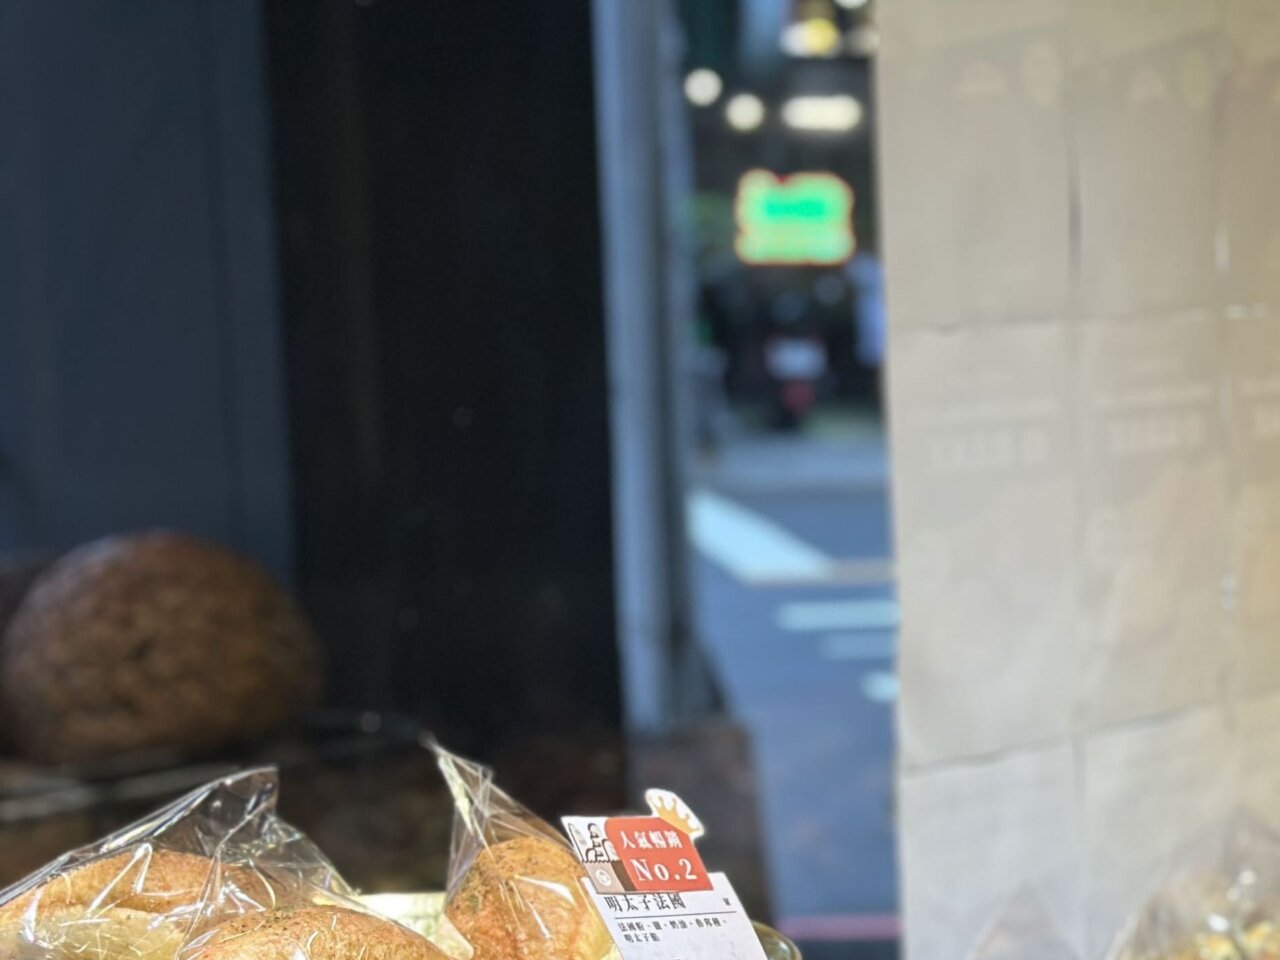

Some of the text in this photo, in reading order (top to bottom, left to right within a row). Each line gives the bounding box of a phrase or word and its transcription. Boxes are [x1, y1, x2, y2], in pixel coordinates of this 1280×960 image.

[619, 829, 684, 850] 人氣暢銷
[629, 857, 699, 882] No.2
